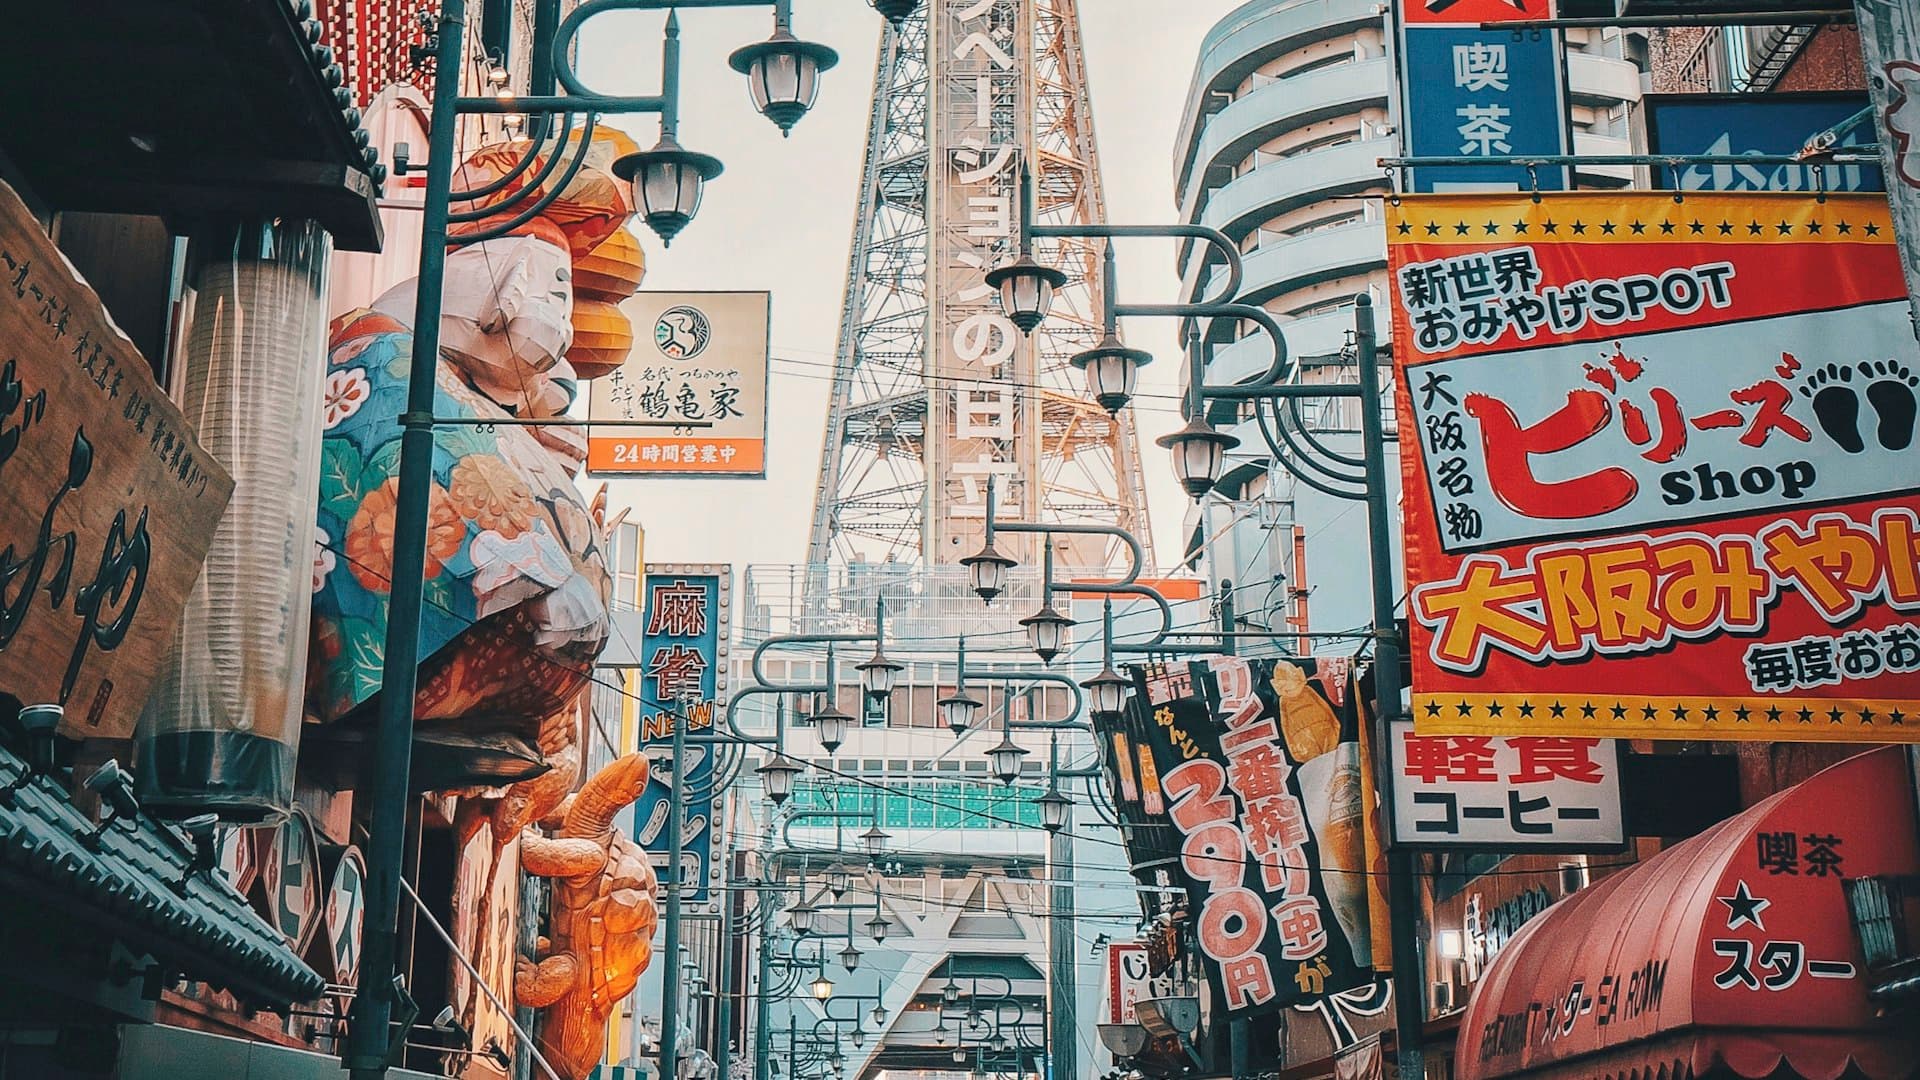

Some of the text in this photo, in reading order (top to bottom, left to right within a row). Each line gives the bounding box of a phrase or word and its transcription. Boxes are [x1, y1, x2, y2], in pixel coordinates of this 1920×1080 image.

[1452, 41, 1513, 157] 喫茶
[1401, 249, 1539, 310] 新世界
[1413, 264, 1732, 349] おみやげSPOT
[639, 381, 745, 421] 鶴亀家
[614, 444, 737, 464] 24時間営業中
[1419, 370, 1482, 542] 大阪名物
[1464, 341, 1812, 519] ビリーズ
[644, 580, 710, 702] 麻雀
[641, 698, 715, 743] NEW
[1403, 731, 1605, 785] 軽食
[1413, 790, 1600, 835] コーヒー
[1756, 832, 1844, 878] 喫茶
[1161, 758, 1276, 1012] 290円
[1712, 938, 1857, 991] スター
